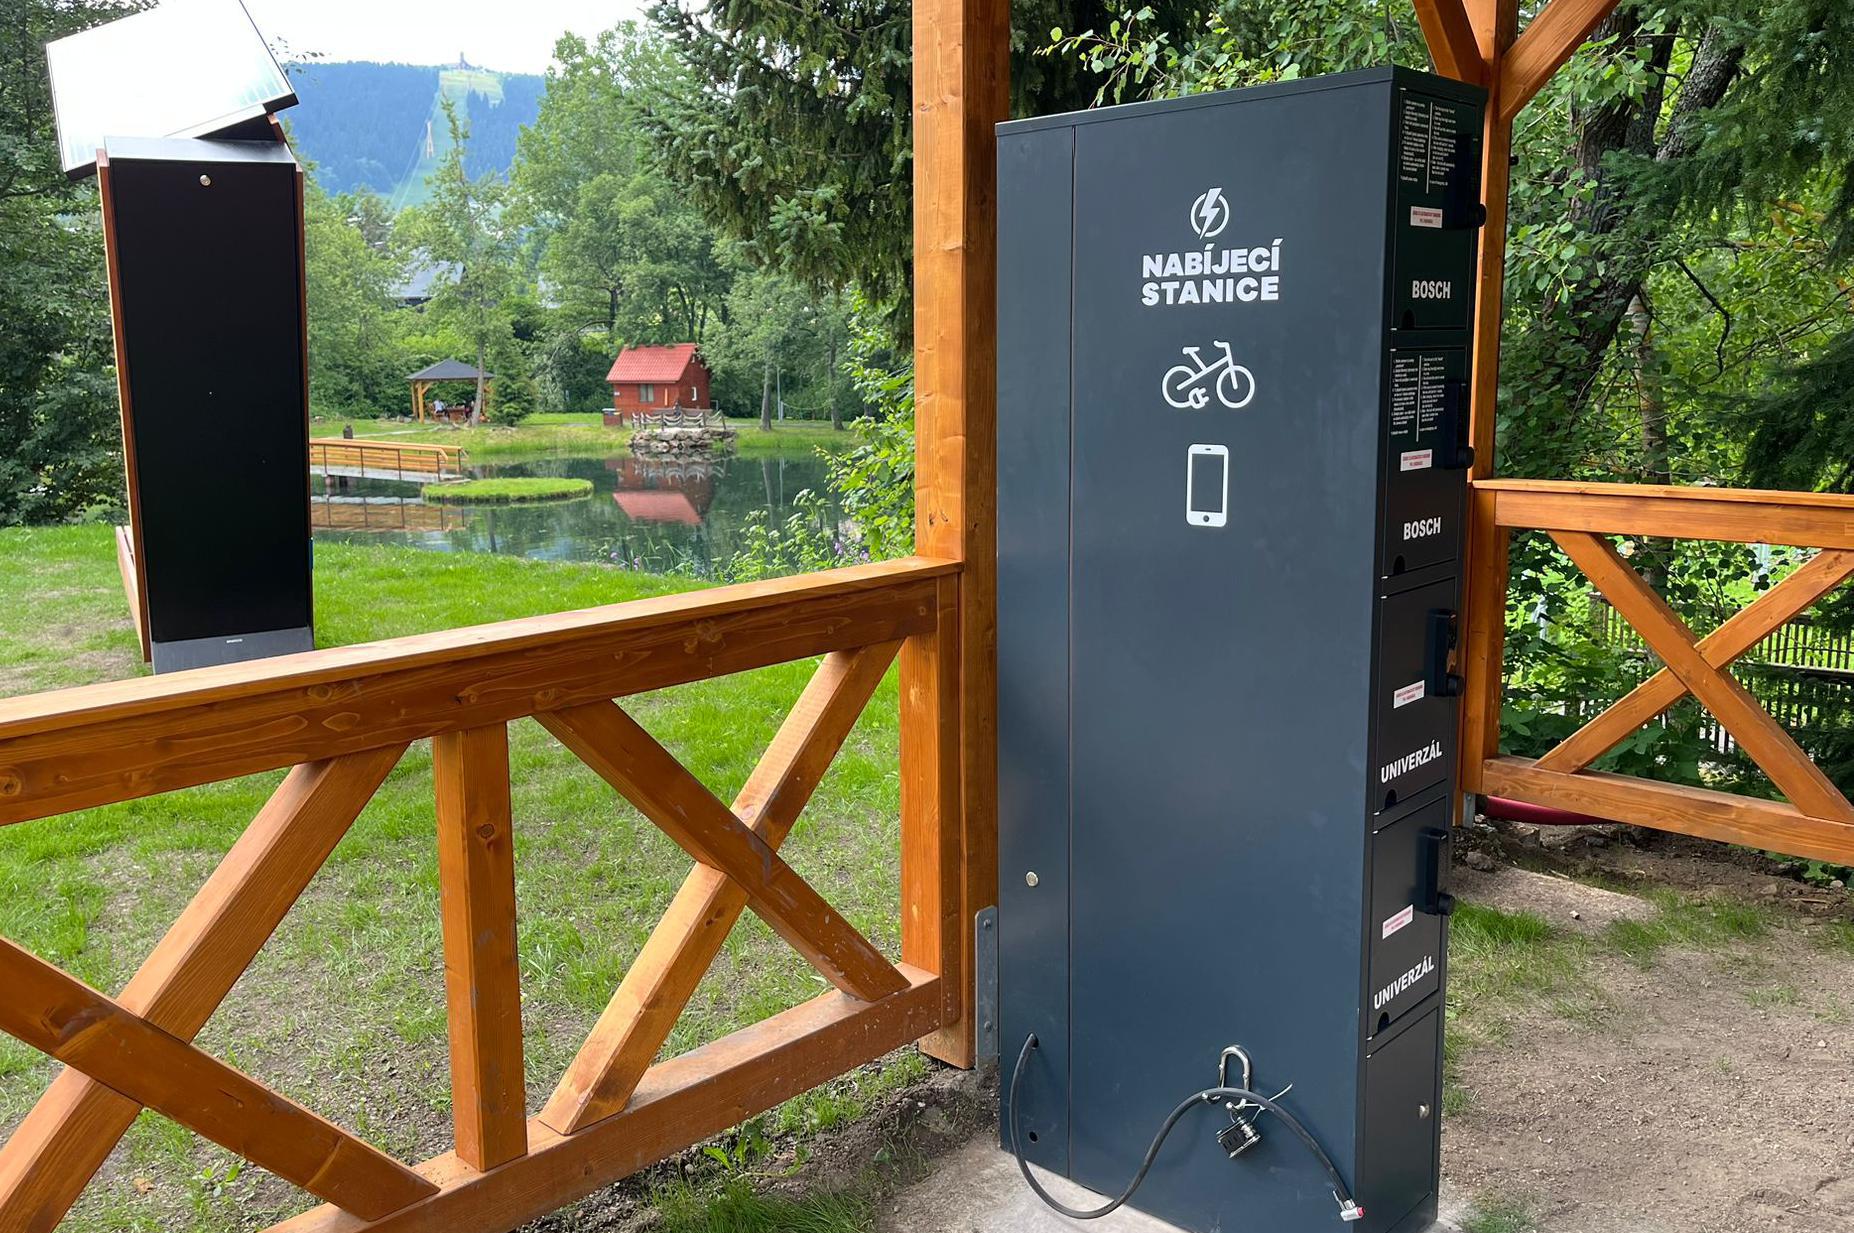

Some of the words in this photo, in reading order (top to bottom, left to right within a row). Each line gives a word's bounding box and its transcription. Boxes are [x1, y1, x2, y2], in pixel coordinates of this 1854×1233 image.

[1142, 238, 1284, 279] NABÍJECÍ
[1141, 275, 1280, 307] STANICE
[1411, 279, 1451, 300] BOSCH
[1402, 516, 1442, 541] BOSCH
[1380, 739, 1443, 785] UNIVERZÁL
[1373, 955, 1435, 1010] UNIVERZÁL
